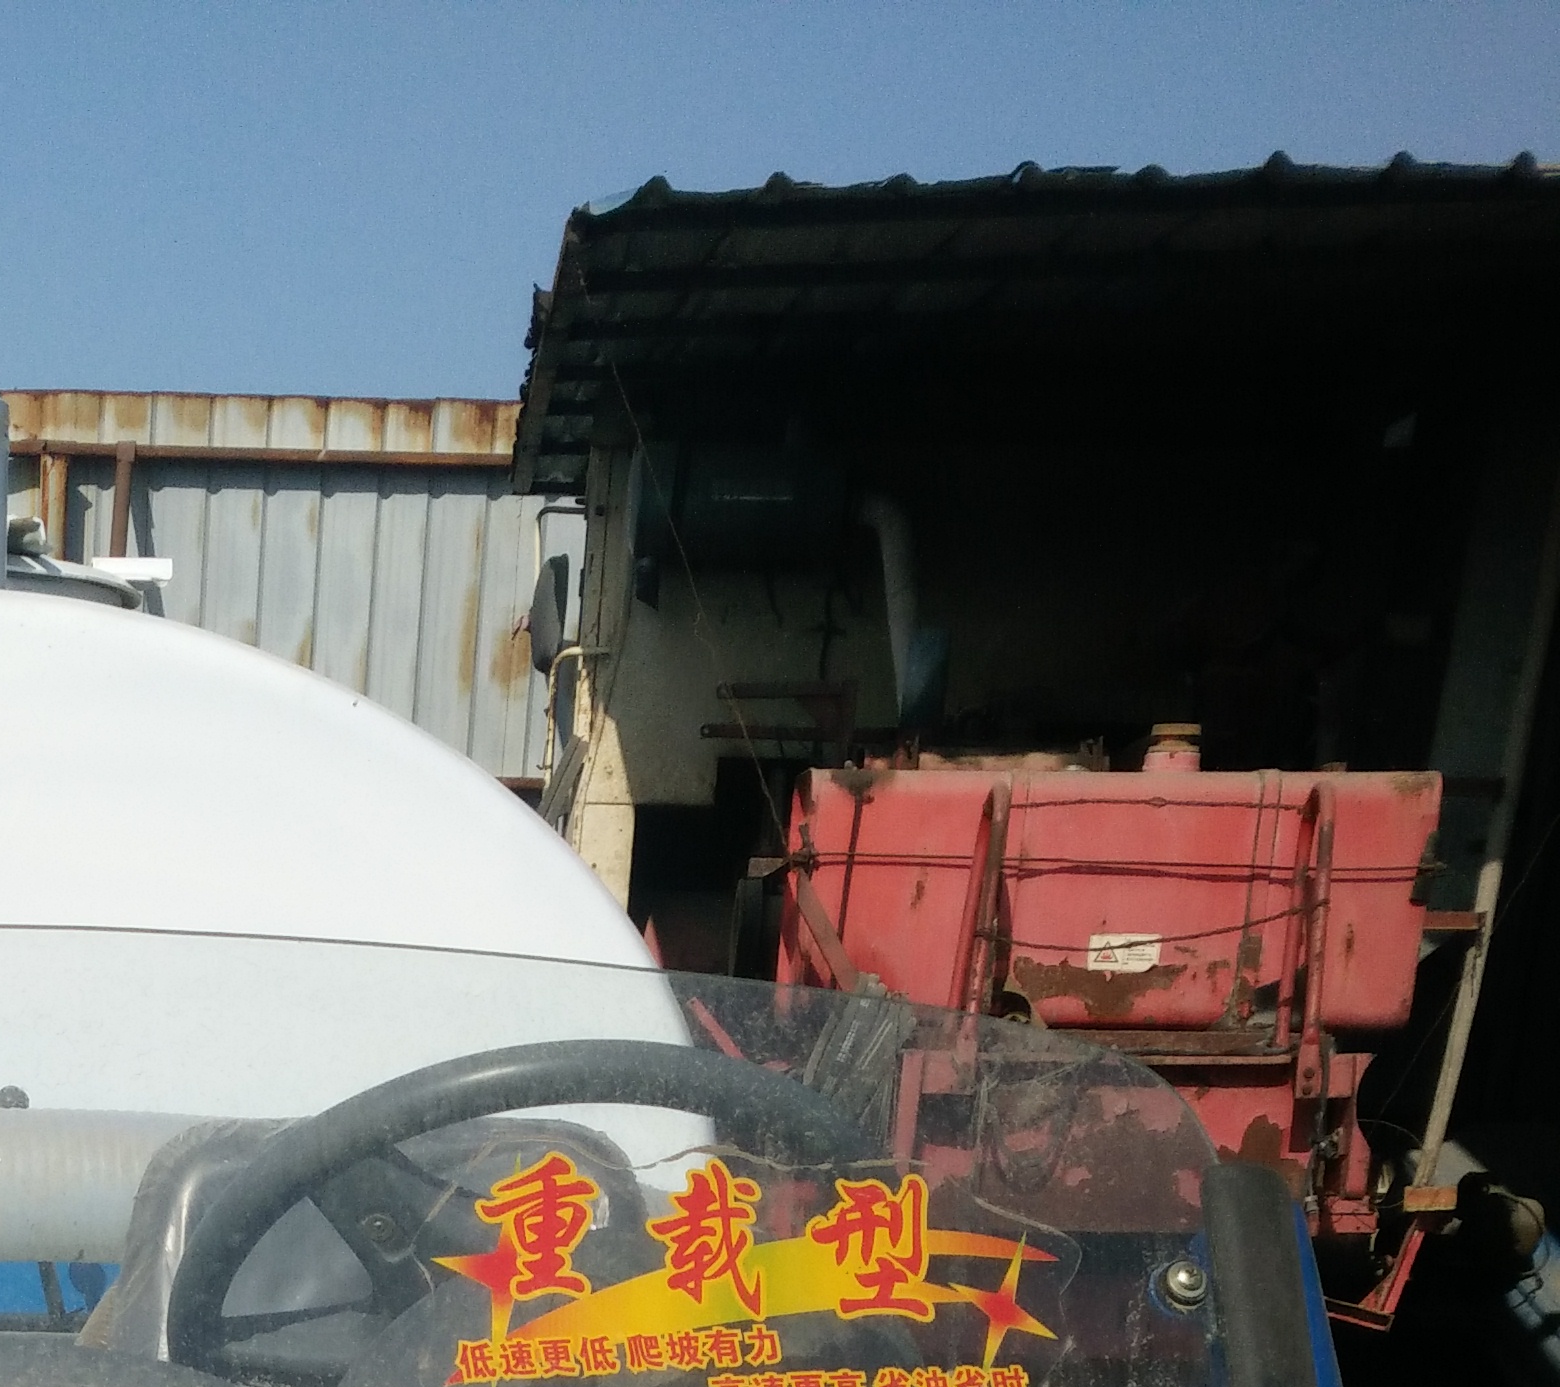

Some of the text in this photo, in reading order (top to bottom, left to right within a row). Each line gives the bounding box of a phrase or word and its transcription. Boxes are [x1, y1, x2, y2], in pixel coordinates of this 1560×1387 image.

[475, 1151, 935, 1322] 重载型
[455, 1325, 782, 1380] 低速更低 爬坡有力
